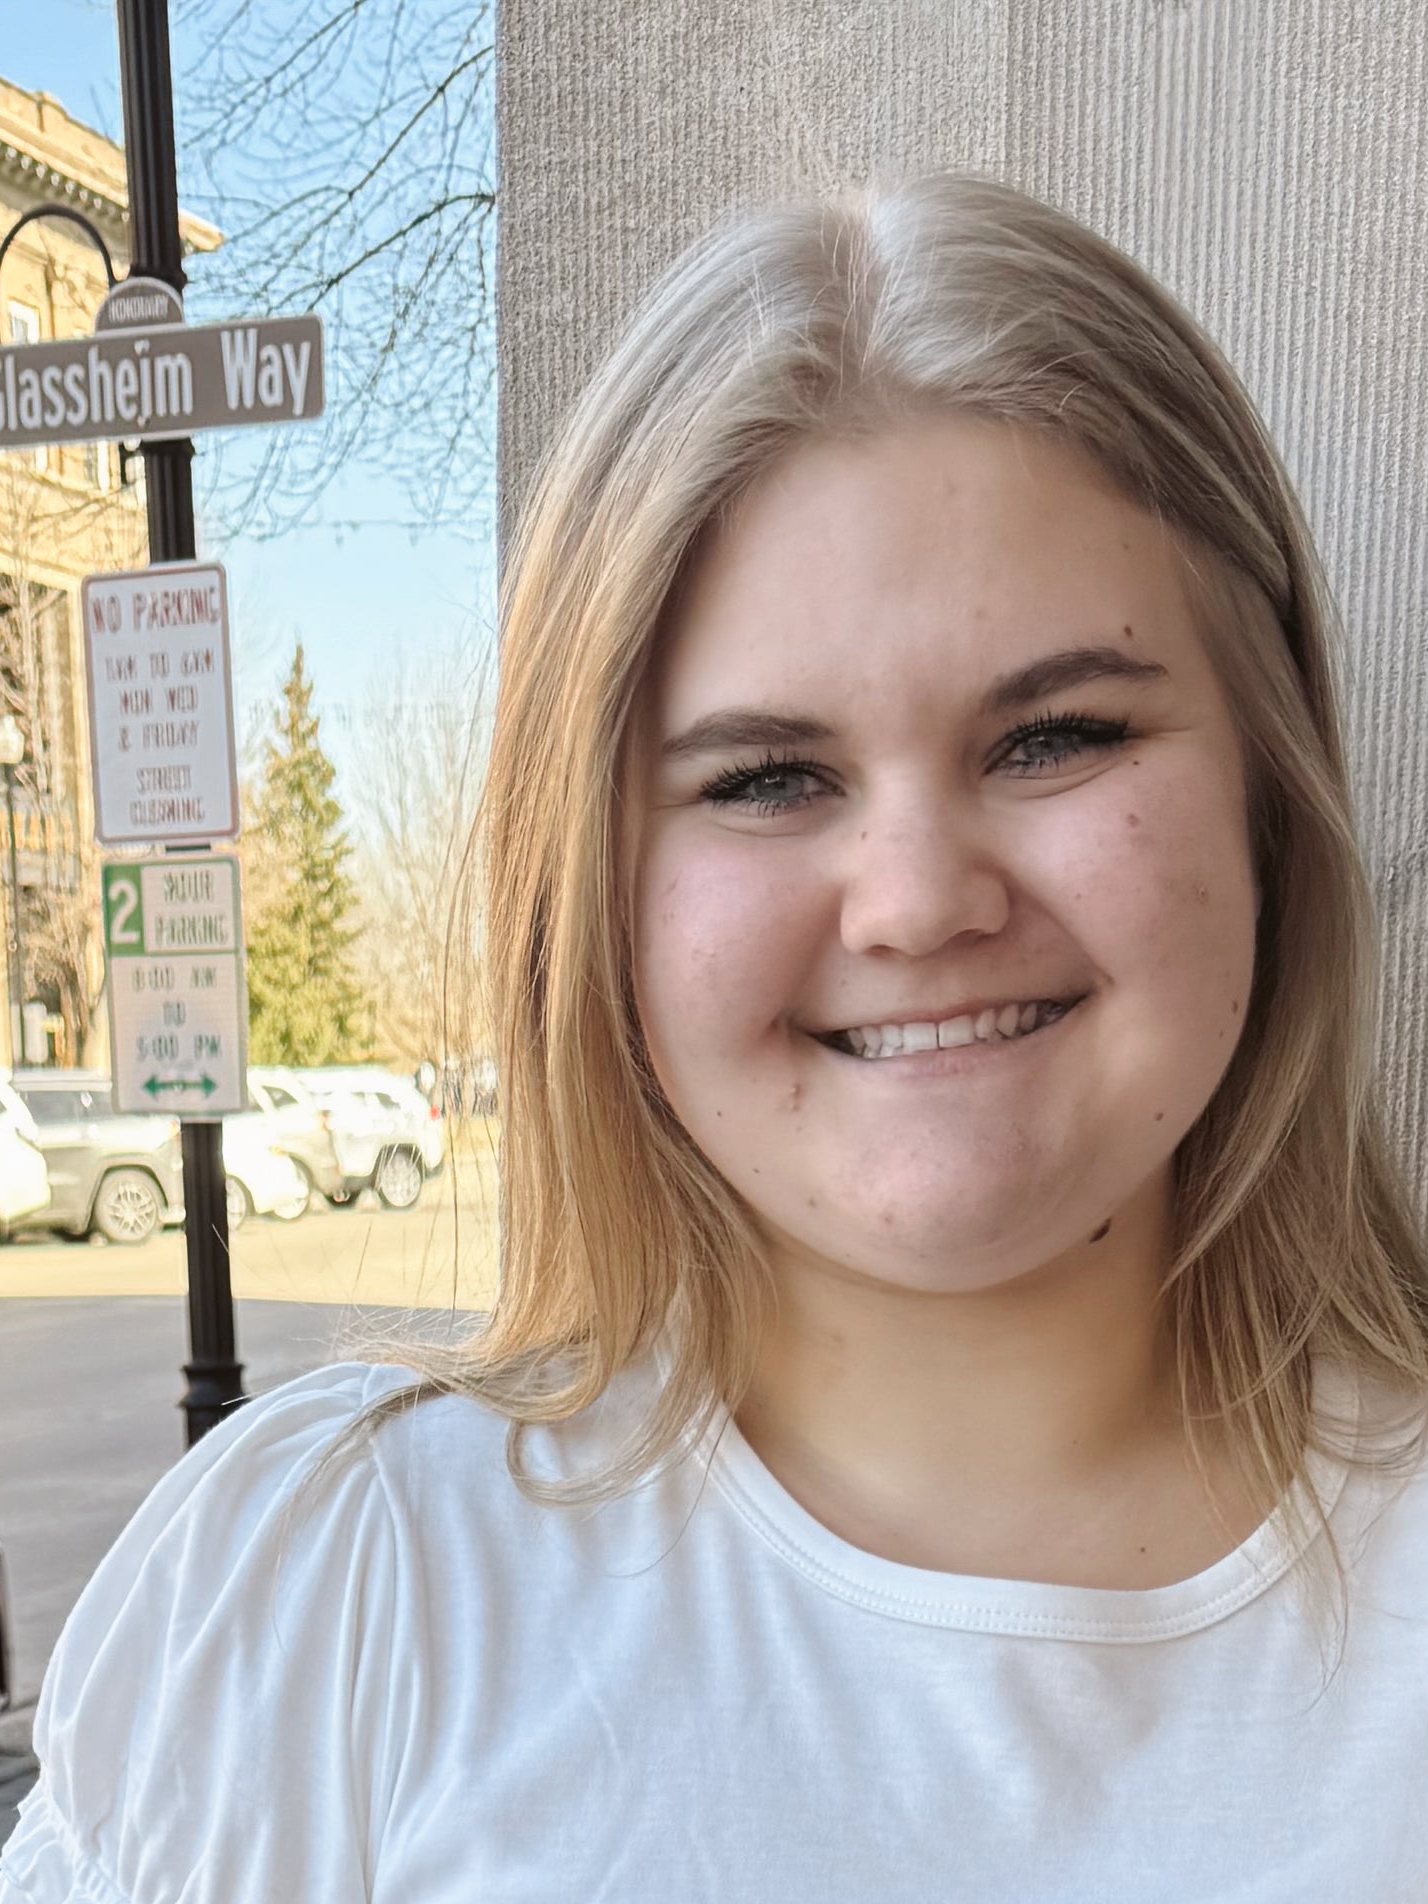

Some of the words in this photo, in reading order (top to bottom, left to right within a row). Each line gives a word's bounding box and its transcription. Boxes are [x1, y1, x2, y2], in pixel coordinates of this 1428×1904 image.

[221, 328, 312, 416] Way
[92, 594, 122, 634] NO
[133, 587, 220, 631] PARKING
[150, 651, 170, 679] TO
[166, 684, 199, 712] WED
[142, 719, 199, 750] FRIDAY
[136, 764, 192, 795] STREET
[130, 796, 205, 826] CLEANING
[164, 870, 213, 902] HOUR
[108, 880, 140, 944] 2
[155, 914, 228, 947] PARKING
[163, 1001, 186, 1027] TO
[193, 1033, 222, 1060] PM
